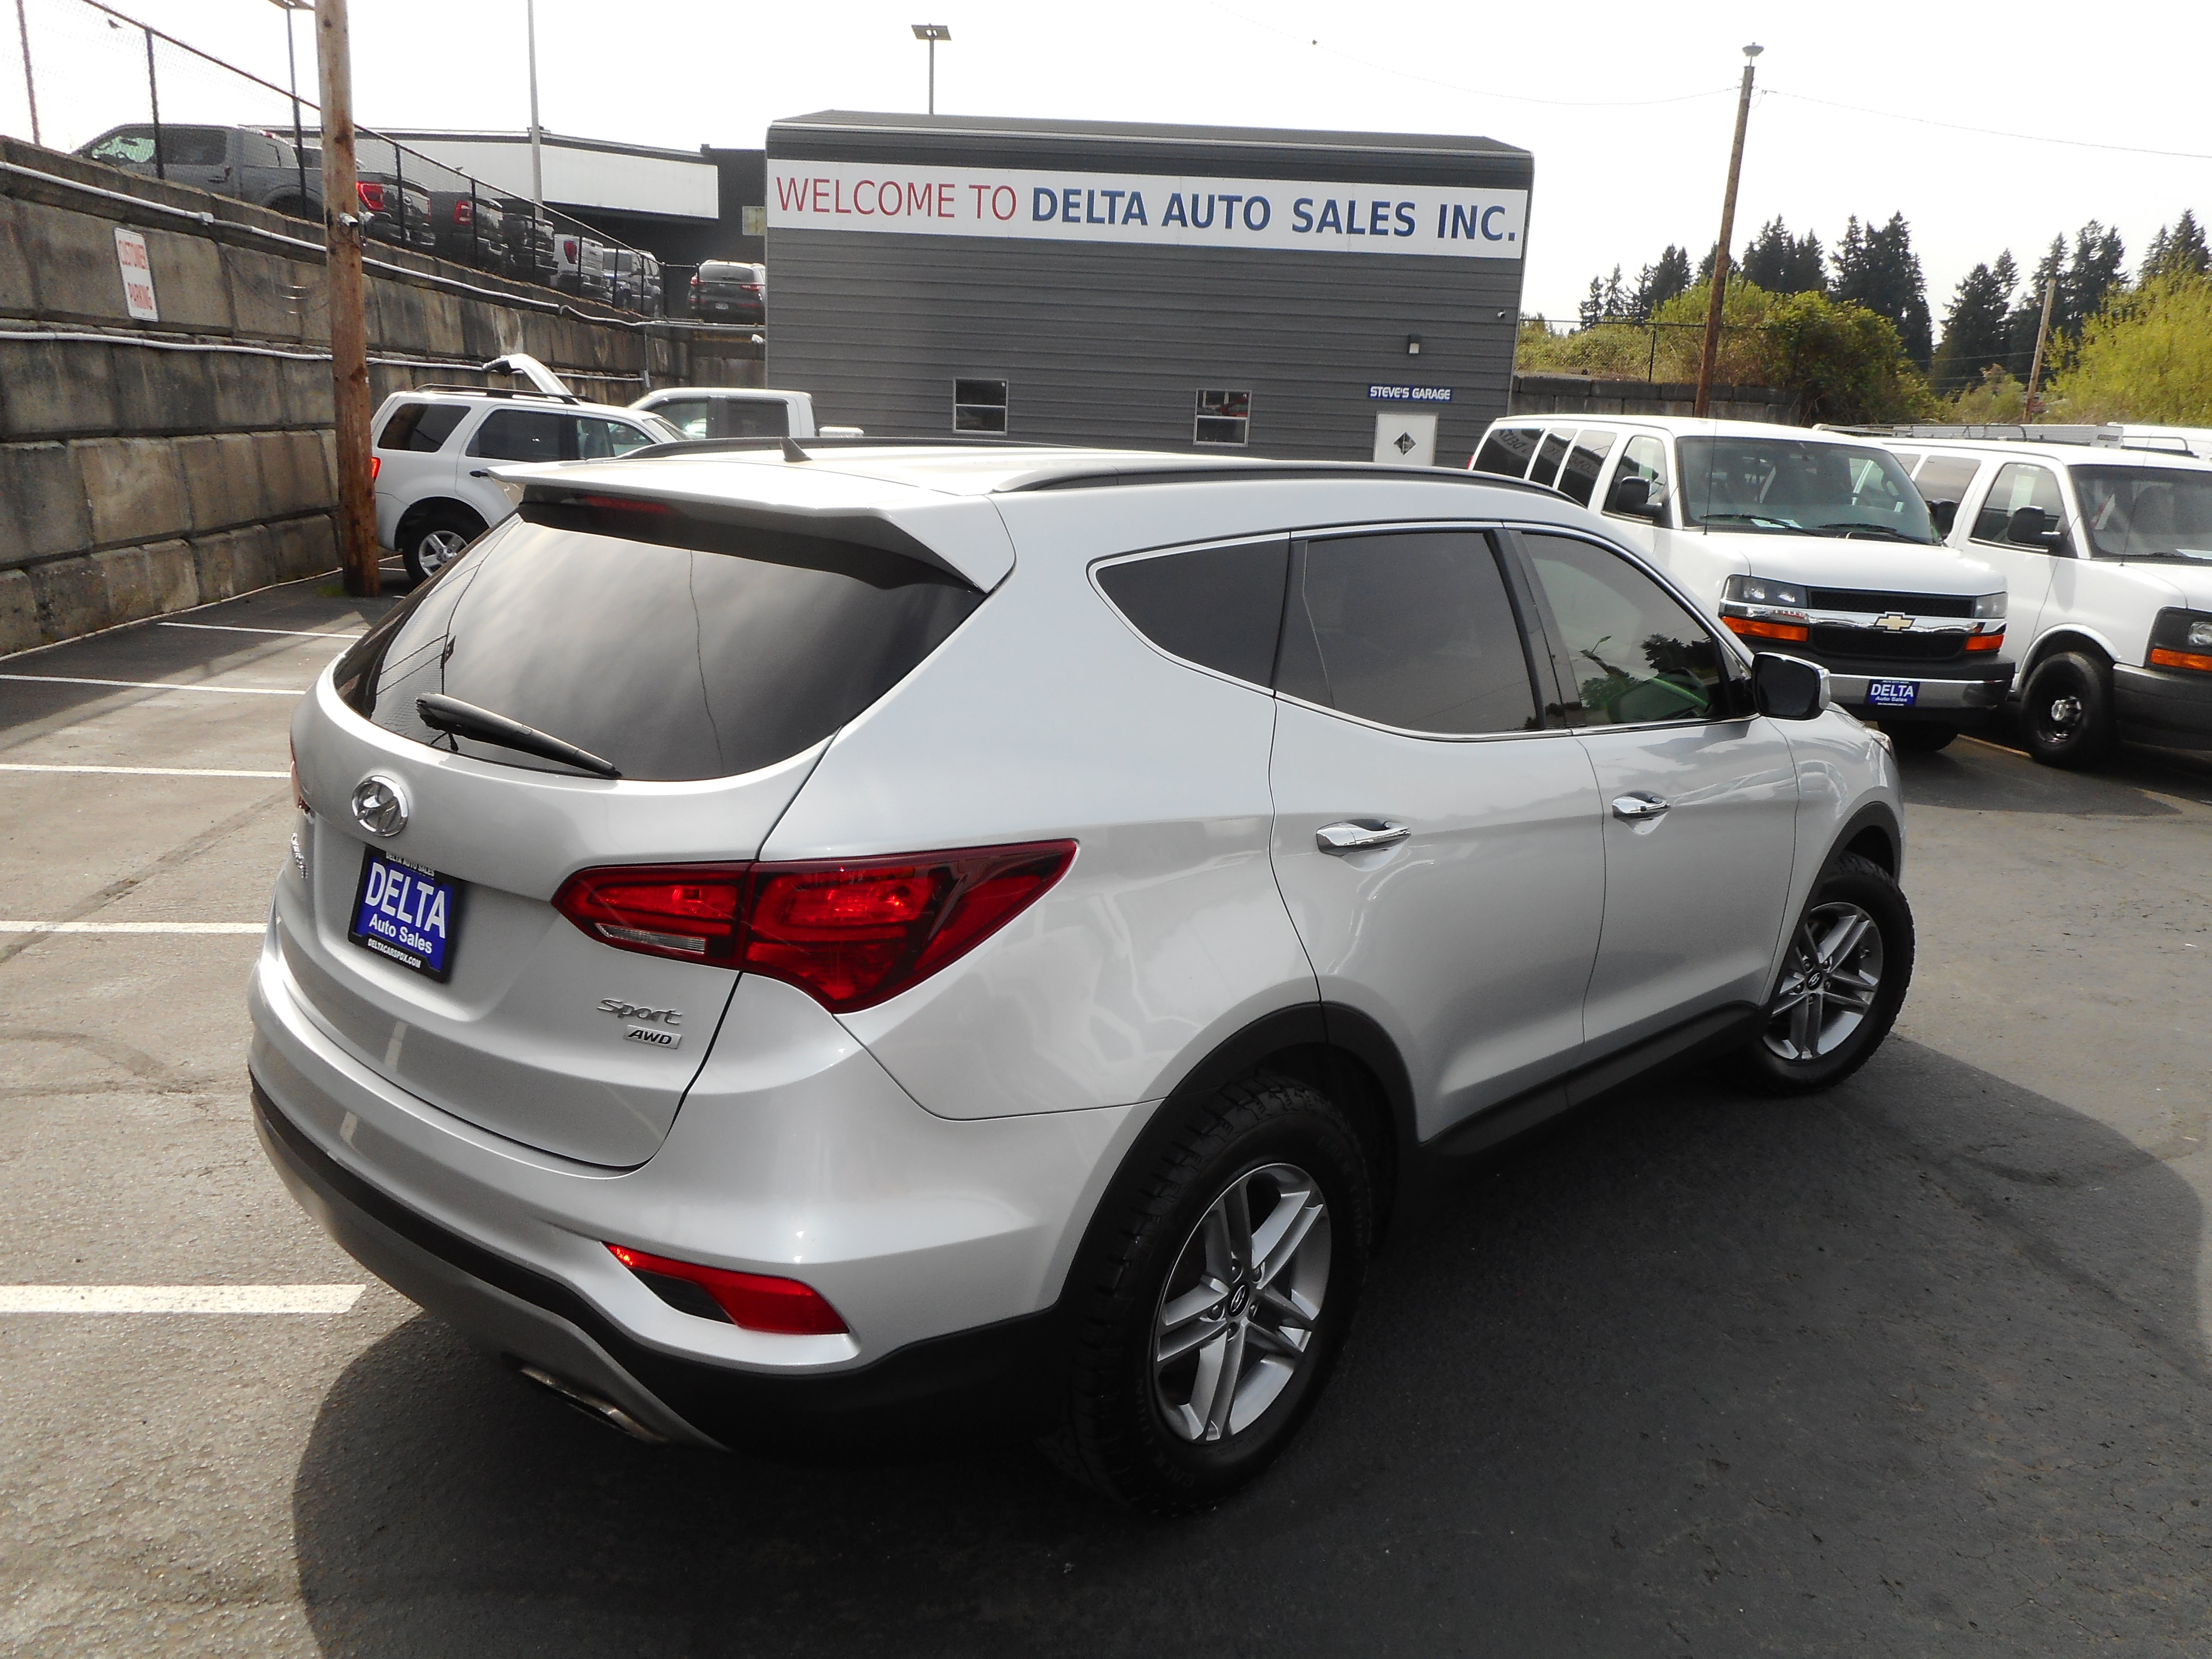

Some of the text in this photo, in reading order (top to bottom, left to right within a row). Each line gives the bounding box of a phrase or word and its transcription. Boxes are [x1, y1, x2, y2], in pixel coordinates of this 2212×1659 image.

[776, 176, 1516, 241] WELCOME TO DELTA AUTO SALES INC.
[1370, 386, 1451, 400] STEVE'S GARAGE
[1871, 684, 1914, 697] DELTA
[365, 862, 445, 939] DELTA
[369, 914, 432, 954] Auto Sales
[368, 938, 421, 968] DELTACARSPDX.COM
[597, 998, 684, 1025] Sport
[628, 1030, 672, 1045] AWD
